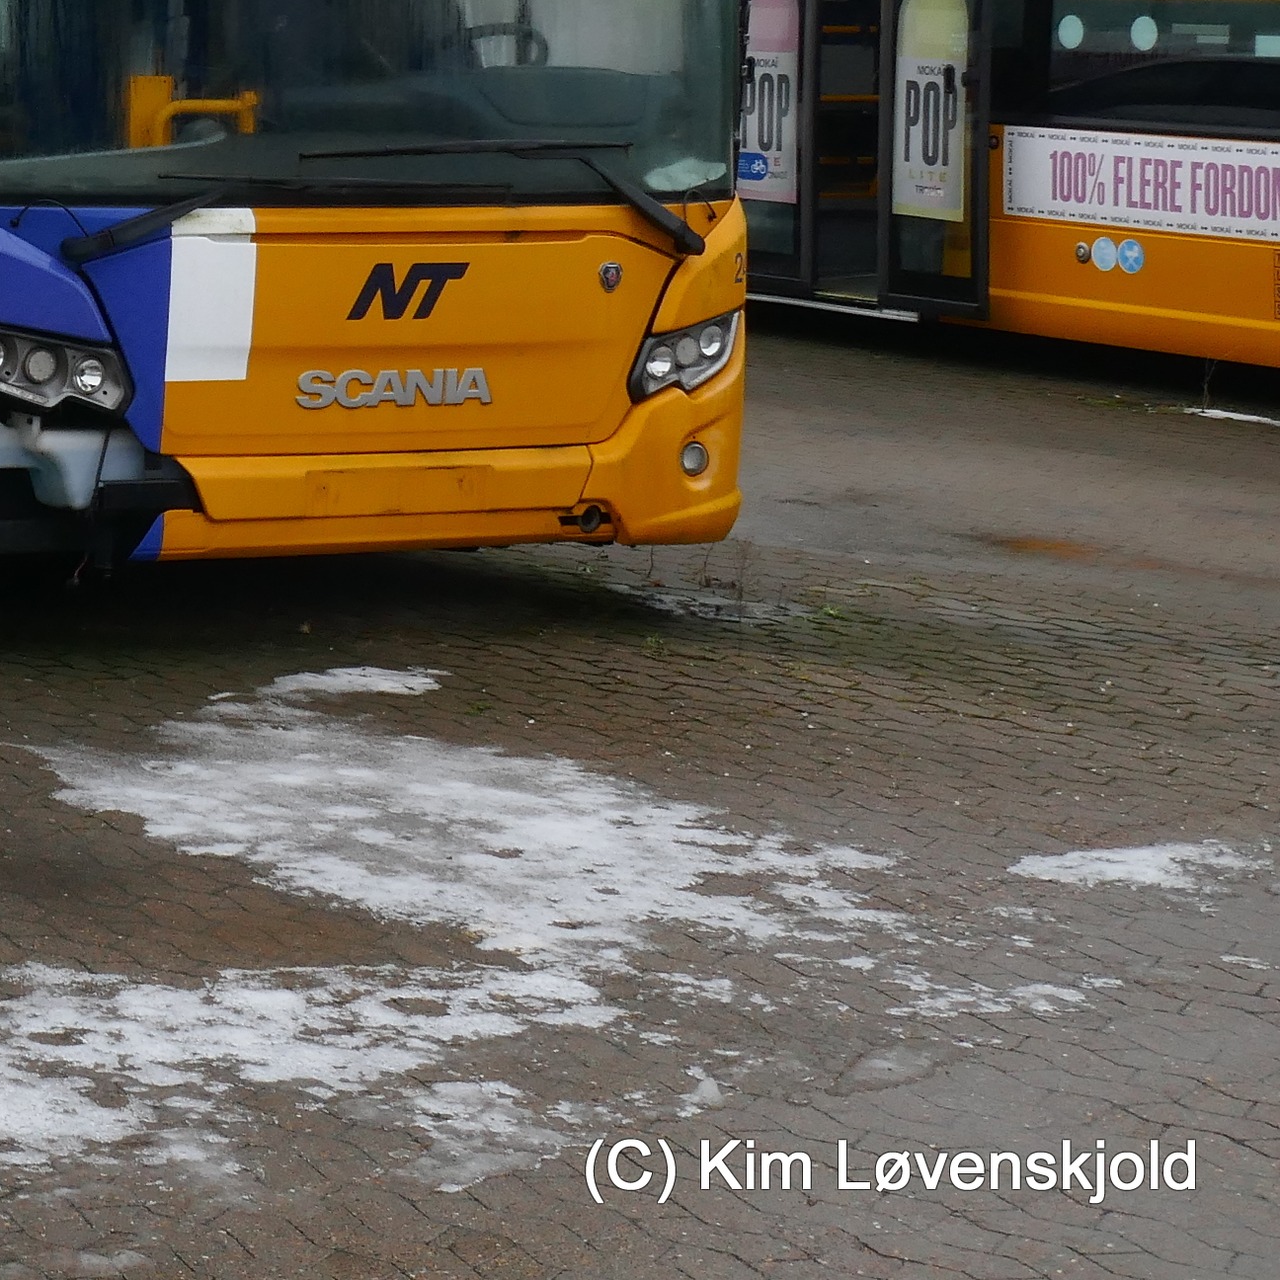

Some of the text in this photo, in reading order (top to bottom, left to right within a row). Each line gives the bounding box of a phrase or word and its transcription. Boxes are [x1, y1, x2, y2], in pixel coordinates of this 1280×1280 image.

[741, 72, 790, 152] POP
[904, 80, 958, 167] POP
[908, 168, 947, 183] LITE
[1049, 150, 1105, 205] 100%
[1113, 155, 1182, 213] FLERE
[346, 262, 471, 320] NT
[295, 368, 493, 409] SCANIA
